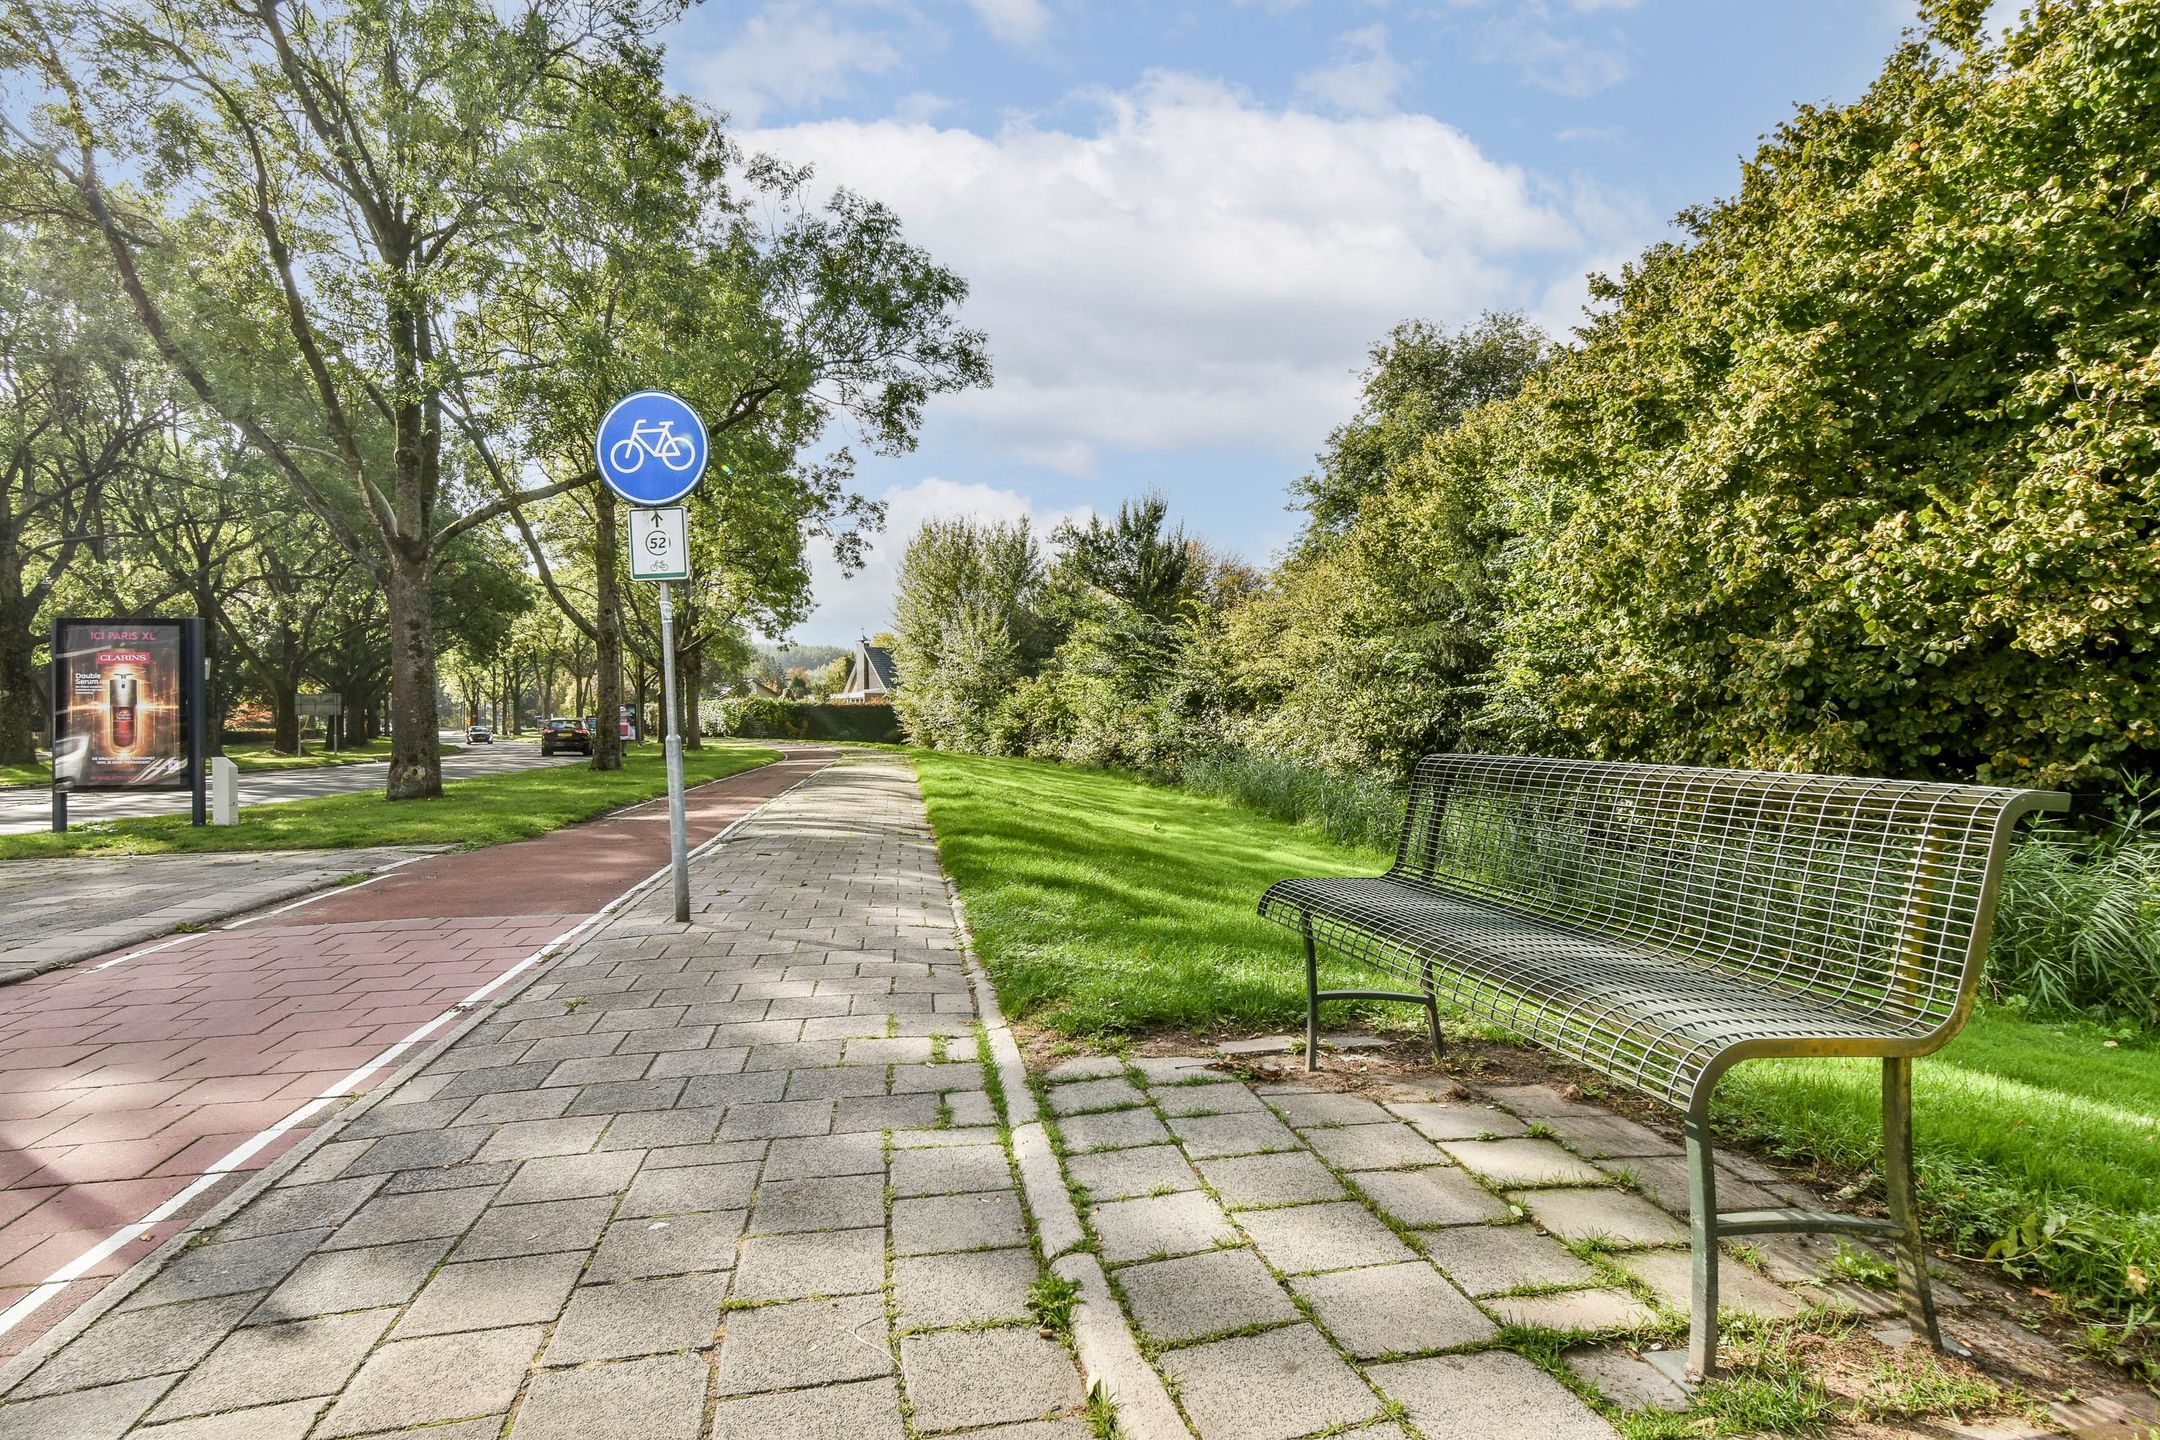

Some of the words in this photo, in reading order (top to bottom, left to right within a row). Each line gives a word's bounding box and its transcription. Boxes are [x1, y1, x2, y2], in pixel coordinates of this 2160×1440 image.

[649, 537, 666, 549] 52
[90, 631, 105, 640] ICI
[108, 631, 138, 641] PARIS
[142, 631, 156, 641] XL
[100, 654, 146, 662] CLARINS
